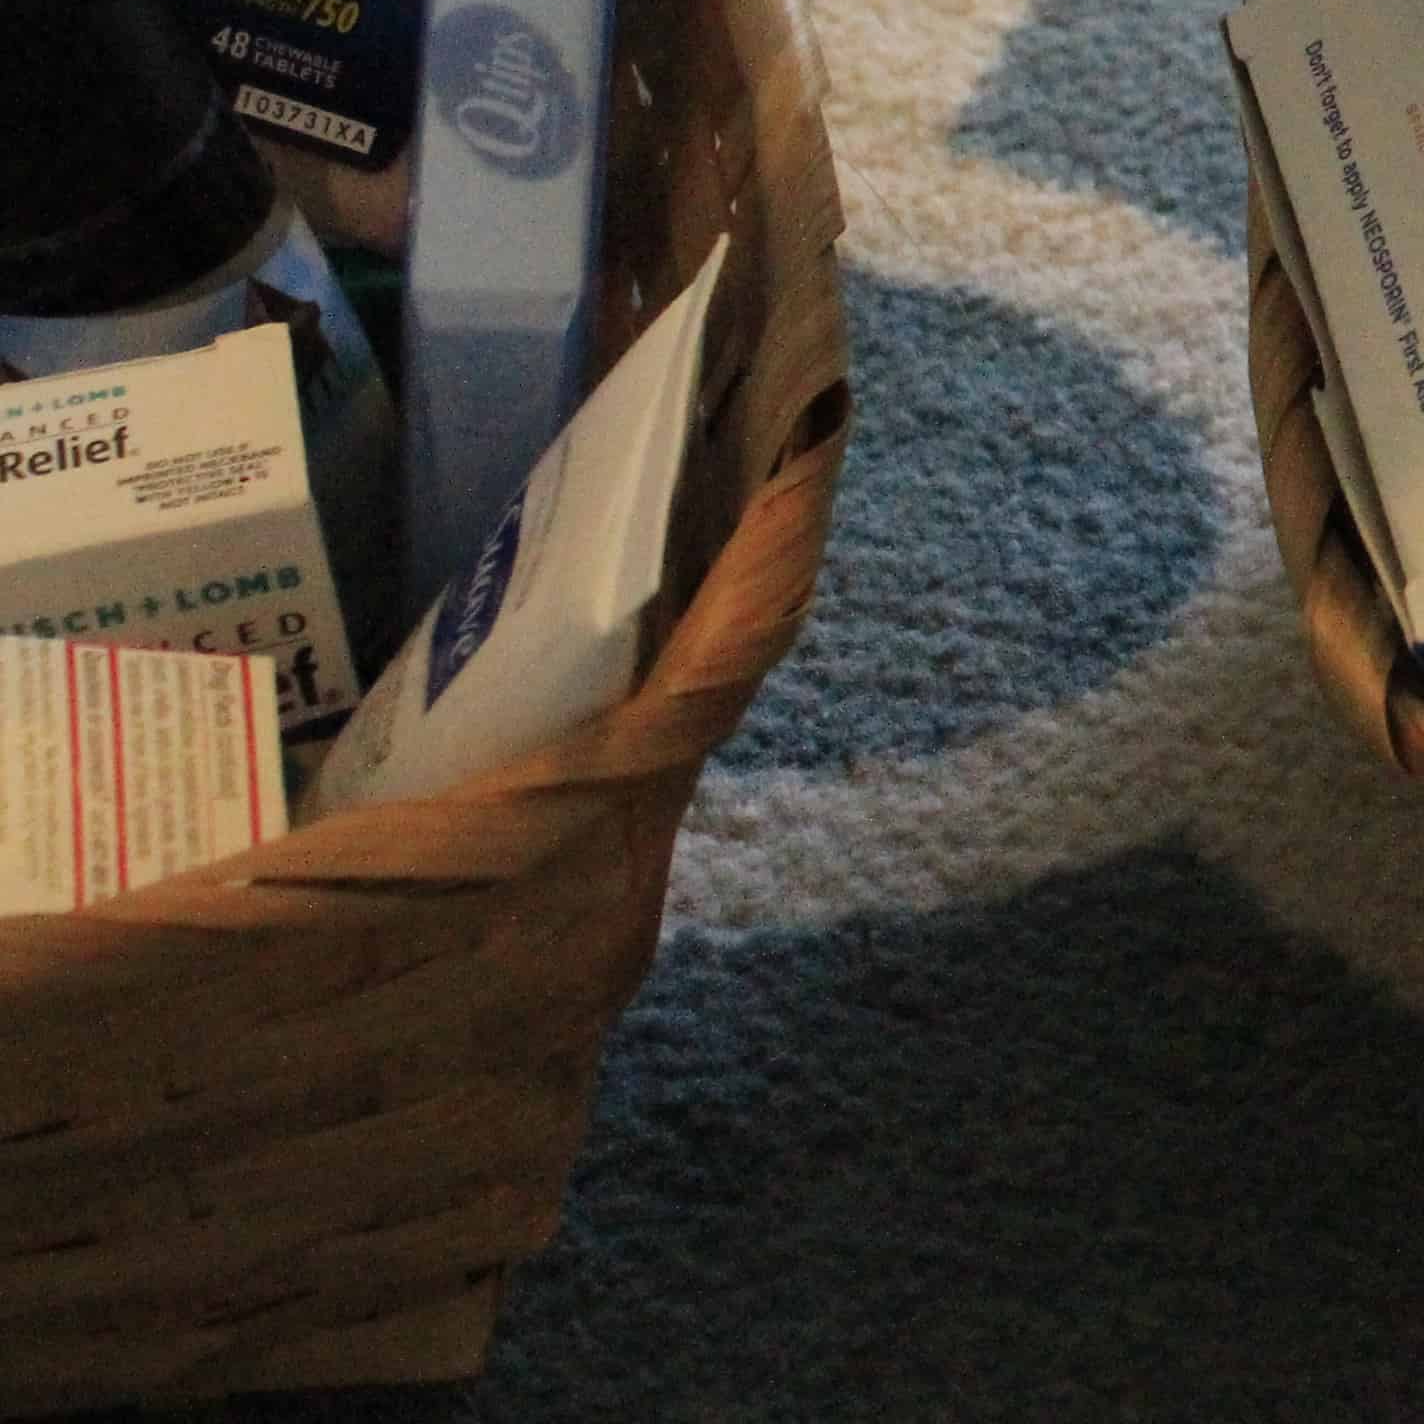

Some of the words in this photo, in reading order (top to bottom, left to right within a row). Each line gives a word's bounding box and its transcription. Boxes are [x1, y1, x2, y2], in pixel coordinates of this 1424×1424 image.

[210, 25, 252, 60] 48
[1304, 39, 1333, 89] Don't
[254, 52, 337, 90] TABLETS
[241, 89, 367, 150] 103731XA
[1319, 84, 1350, 142] forget
[1335, 136, 1353, 161] to
[1341, 161, 1370, 212] apply
[1397, 329, 1424, 376] First
[52, 383, 127, 411] LOMB
[0, 406, 131, 444] ANCED
[0, 425, 130, 480] Relief
[176, 565, 300, 613] LOMB
